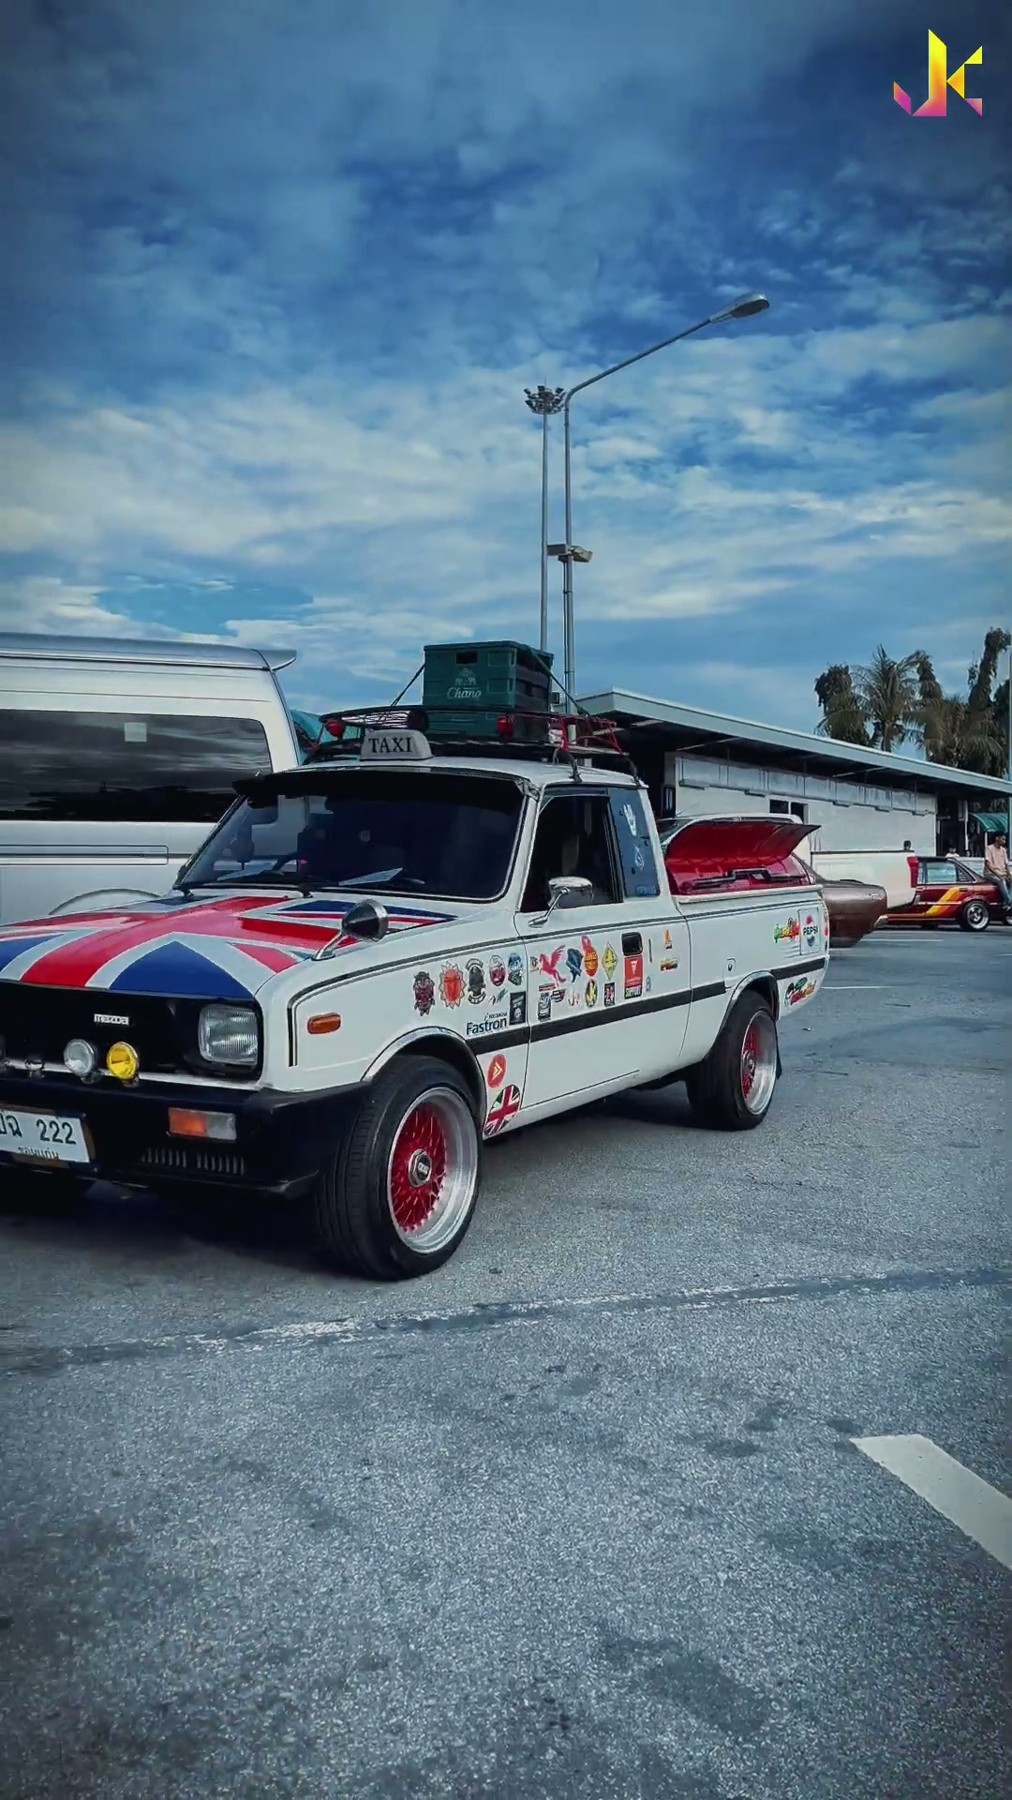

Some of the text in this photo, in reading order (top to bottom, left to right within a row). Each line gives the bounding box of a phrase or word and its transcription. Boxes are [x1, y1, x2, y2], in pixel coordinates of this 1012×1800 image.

[368, 737, 413, 753] TAXI
[803, 926, 818, 935] PEPSI
[466, 1018, 507, 1036] Fastron
[36, 1119, 76, 1144] 222
